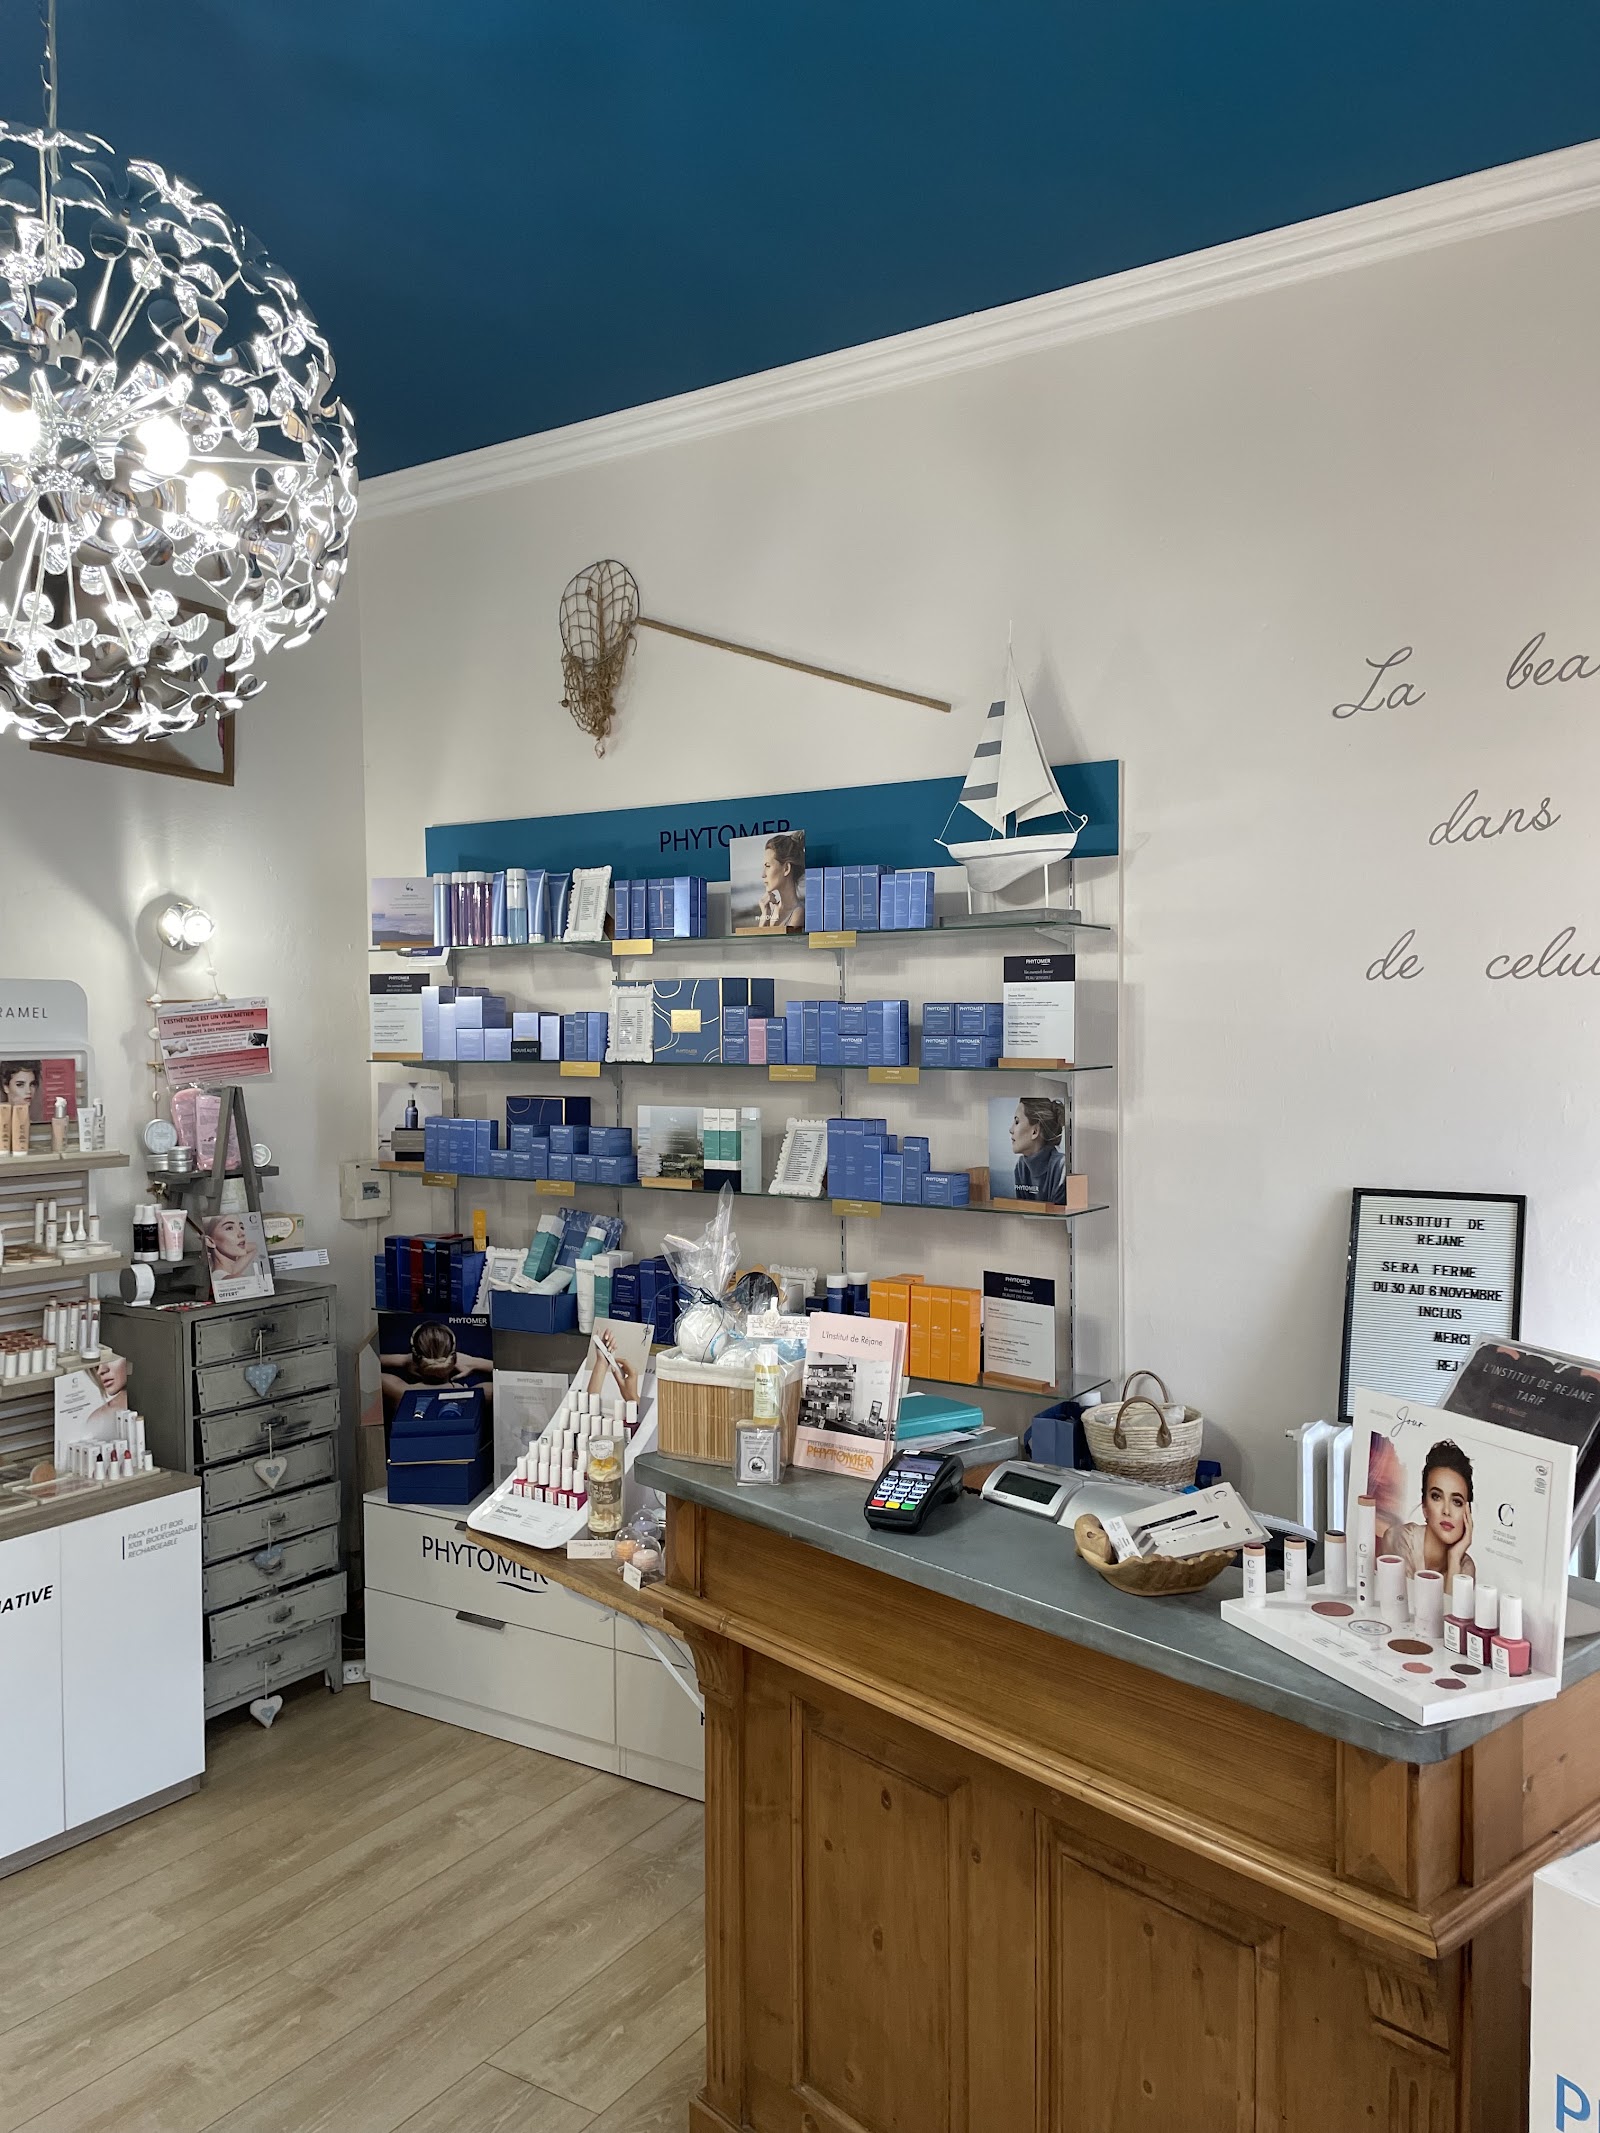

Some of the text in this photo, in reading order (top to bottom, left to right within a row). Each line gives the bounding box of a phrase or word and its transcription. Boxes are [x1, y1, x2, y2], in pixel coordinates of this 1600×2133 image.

[1332, 646, 1427, 719] La
[1428, 789, 1561, 846] dans
[1025, 957, 1051, 966] PHYTOMER
[1366, 929, 1424, 981] de
[926, 1176, 948, 1184] PHYTOMER
[1015, 1184, 1040, 1194] PHYTOMER
[1467, 1219, 1486, 1231] DE
[1417, 1234, 1466, 1247] REJANE
[1381, 1261, 1478, 1279] SERA FERME
[1372, 1281, 1389, 1293] DU
[1391, 1282, 1406, 1294] 30
[1407, 1283, 1425, 1296] AU
[1439, 1286, 1504, 1302] NOVEMBRE
[448, 1316, 488, 1326] PHYTOMER
[1418, 1305, 1463, 1320] INCLUS
[822, 1330, 883, 1347] L'Institut de Réjane
[1433, 1331, 1472, 1346] MERCI
[1437, 1359, 1460, 1372] REJ
[1482, 1362, 1595, 1404] L'INSTITUT DE REJANE
[1515, 1389, 1546, 1406] TARIF
[1390, 1405, 1428, 1437] Jour
[1498, 1503, 1514, 1527] C
[128, 1519, 184, 1541] PACK PLA ET BOIS
[128, 1537, 178, 1559] RECHARGEABLE
[0, 1584, 54, 1614] ATIVE
[1555, 2073, 1600, 2133] P
